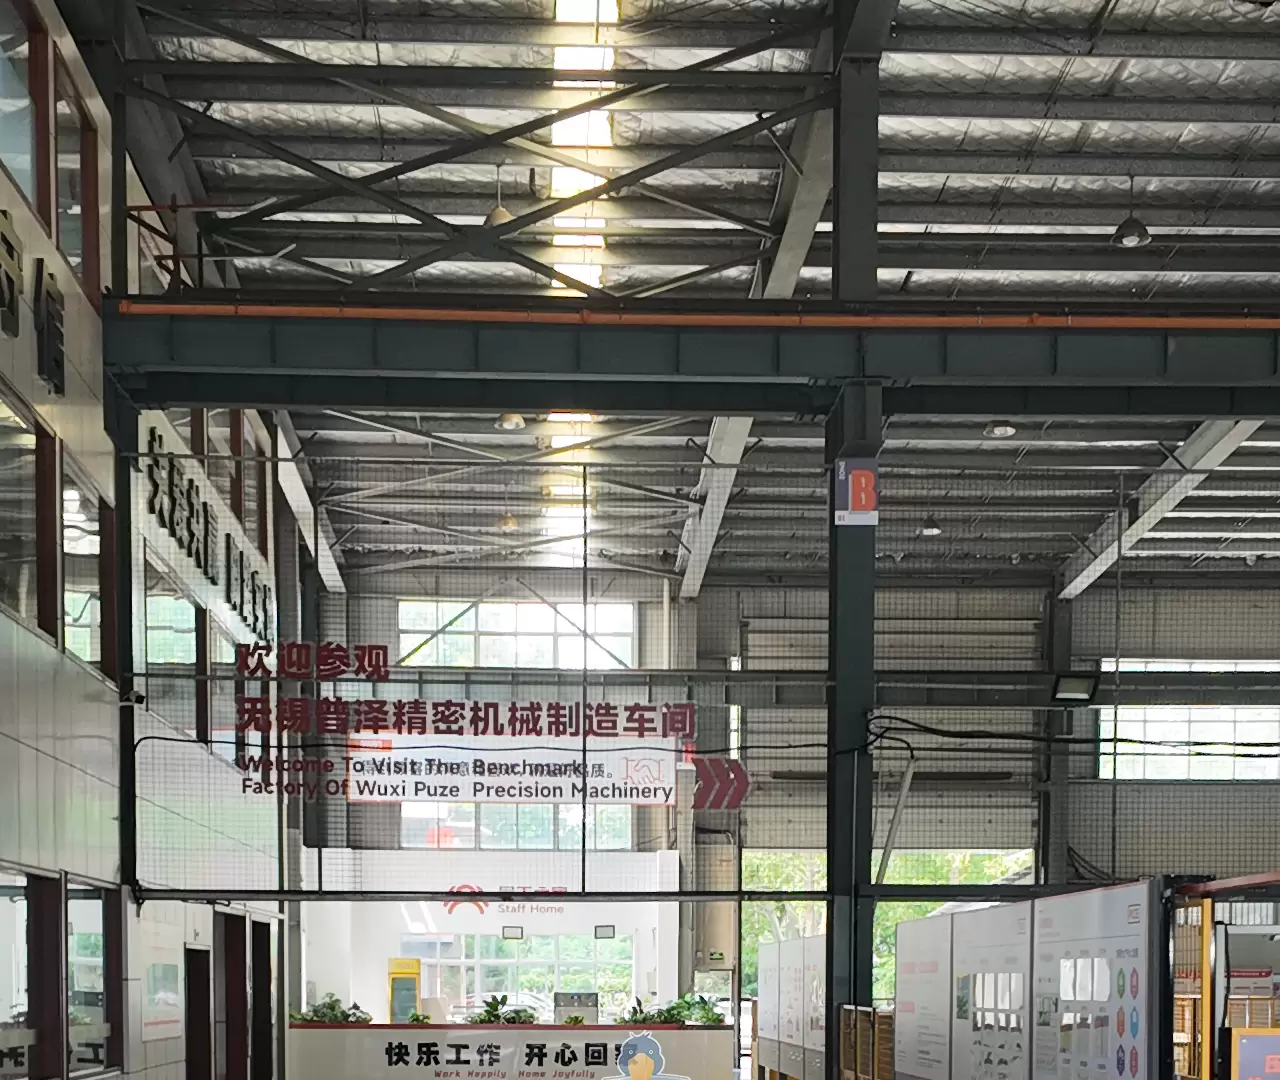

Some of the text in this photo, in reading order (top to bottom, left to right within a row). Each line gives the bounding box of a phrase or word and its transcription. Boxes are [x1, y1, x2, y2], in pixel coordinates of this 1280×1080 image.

[849, 469, 876, 512] B
[236, 641, 390, 682] 欢迎参观
[236, 696, 696, 740] 无锡普泽精密机械制造车间
[239, 753, 335, 774] Welcome
[342, 756, 365, 774] To
[372, 756, 416, 775] Visit
[424, 758, 461, 775] The
[472, 759, 583, 777] Benchmark
[242, 777, 674, 802] Factory Of Wuxi Puze Precision Machinery
[498, 904, 564, 914] Staff Home
[385, 1042, 500, 1066] 快乐工作
